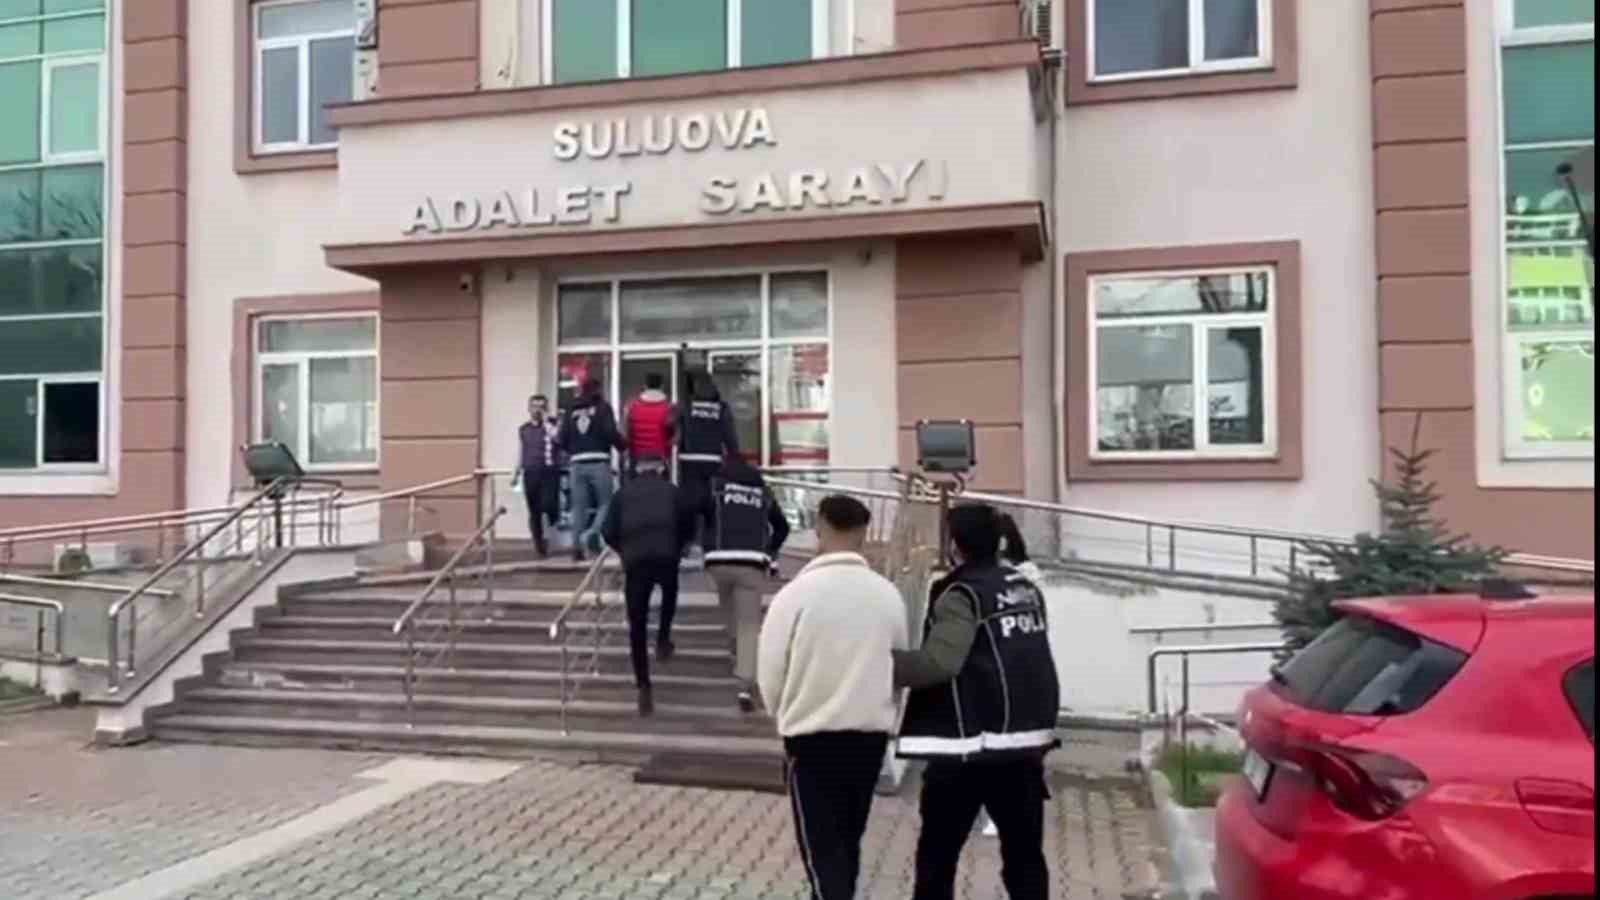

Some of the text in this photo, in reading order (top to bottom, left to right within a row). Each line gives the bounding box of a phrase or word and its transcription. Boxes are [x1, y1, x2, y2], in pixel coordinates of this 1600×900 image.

[553, 108, 777, 160] SULUOVA
[403, 159, 947, 235] ADALET SARAYI
